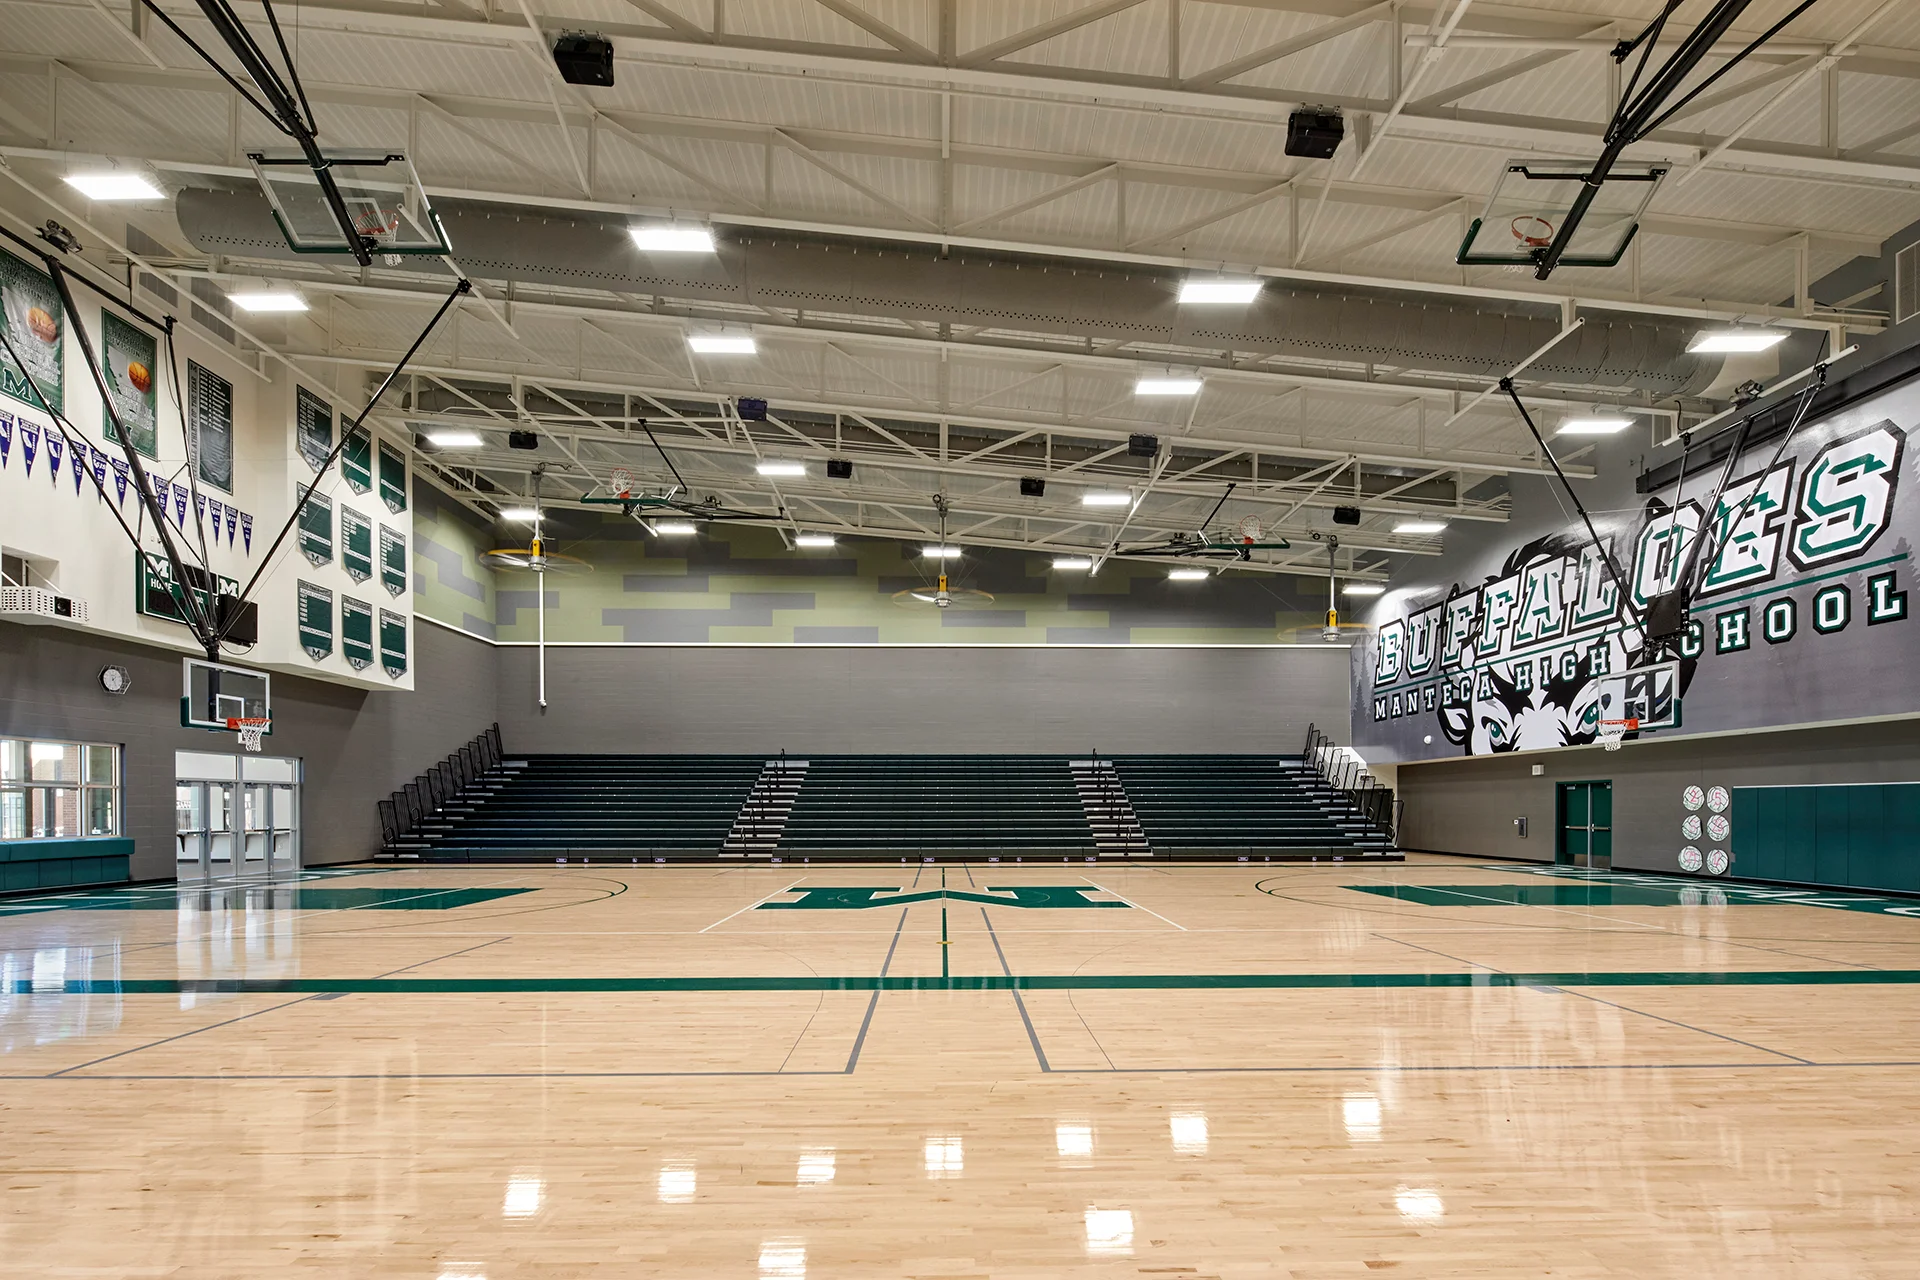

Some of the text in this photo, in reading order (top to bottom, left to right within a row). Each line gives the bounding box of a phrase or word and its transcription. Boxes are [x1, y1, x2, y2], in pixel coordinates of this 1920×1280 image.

[3, 368, 32, 401] M
[1374, 418, 1907, 688] BUFFALOES
[147, 555, 169, 578] M
[220, 579, 238, 598] M
[312, 648, 320, 657] M
[1374, 570, 1907, 722] MANTECA HIGH CHOOL
[354, 659, 361, 668] M
[390, 668, 397, 676] M
